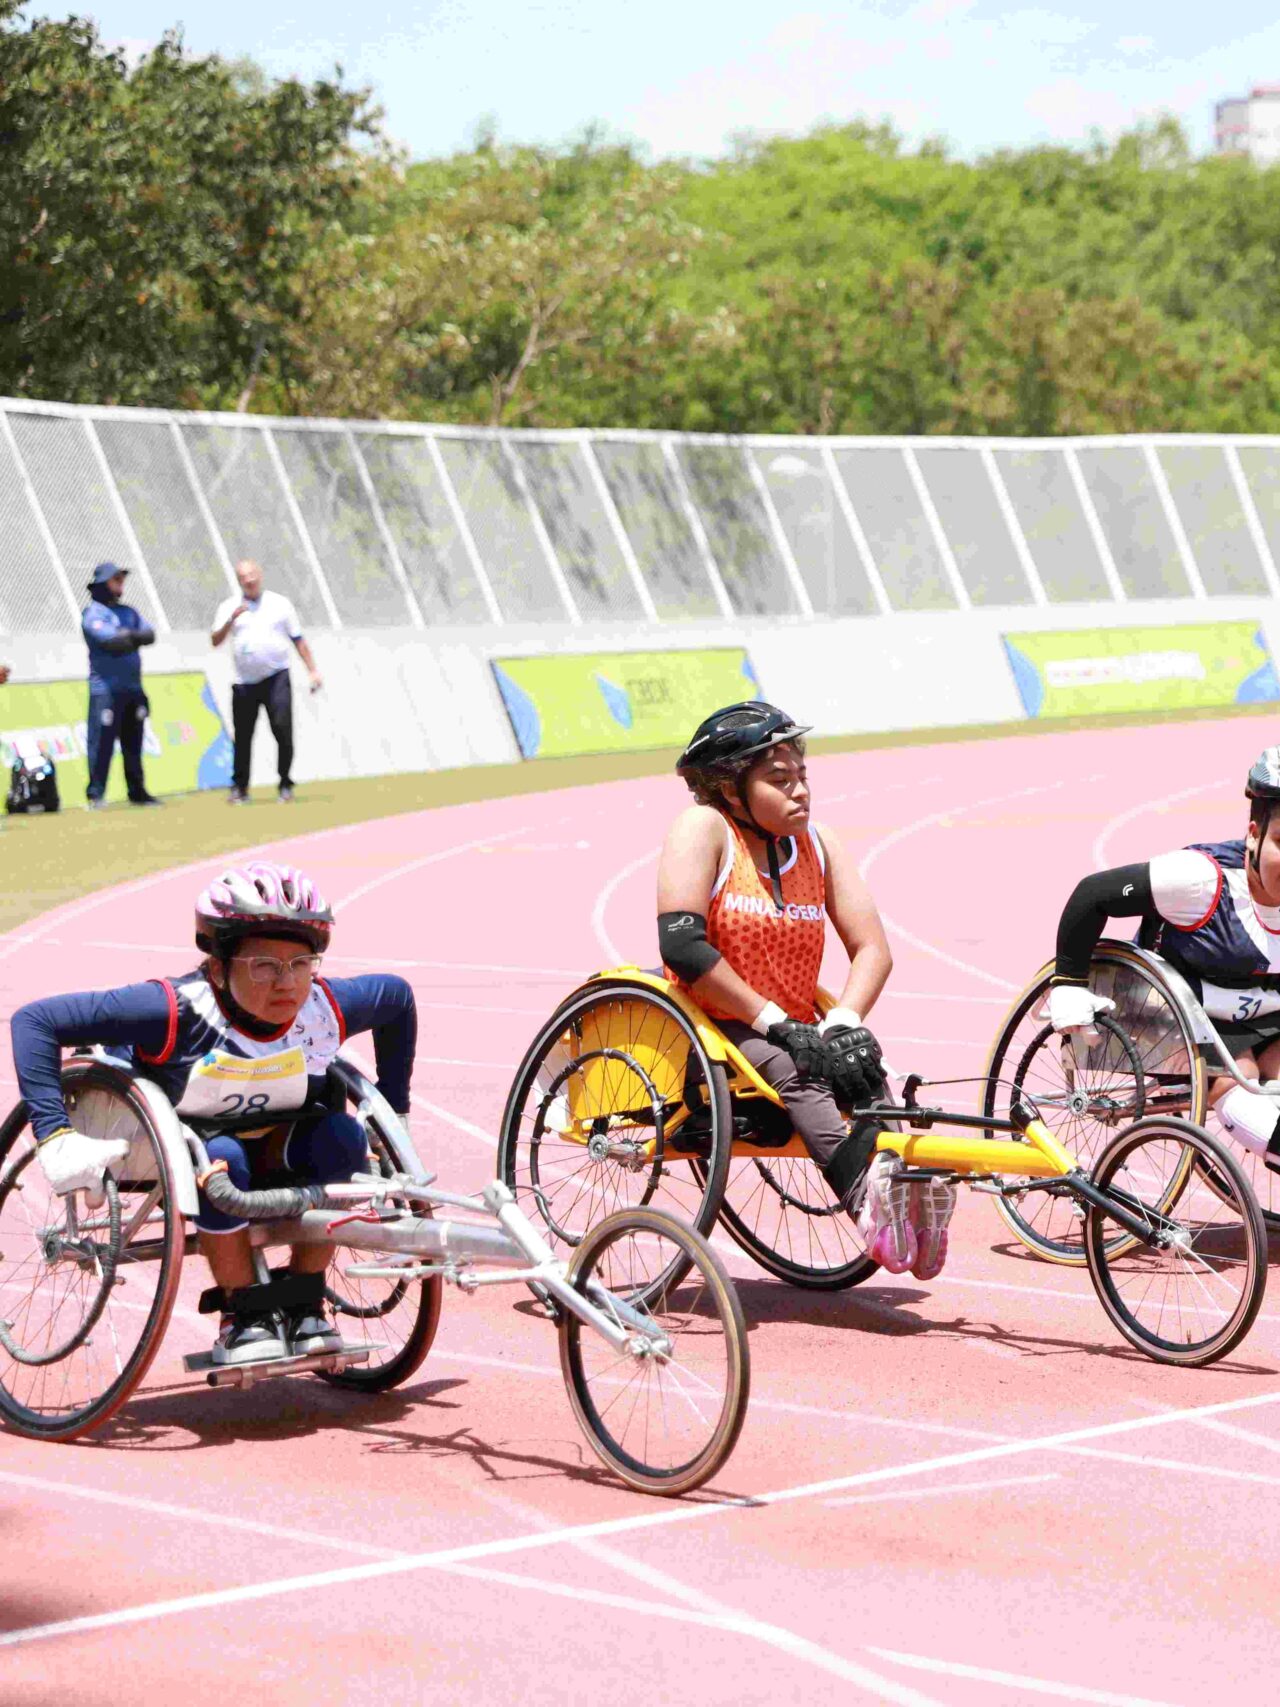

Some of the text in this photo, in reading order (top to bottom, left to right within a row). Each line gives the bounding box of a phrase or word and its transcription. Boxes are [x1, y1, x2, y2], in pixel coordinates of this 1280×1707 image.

[724, 893, 783, 918] MINAS
[1232, 995, 1263, 1024] 31
[213, 1093, 270, 1118] 28
